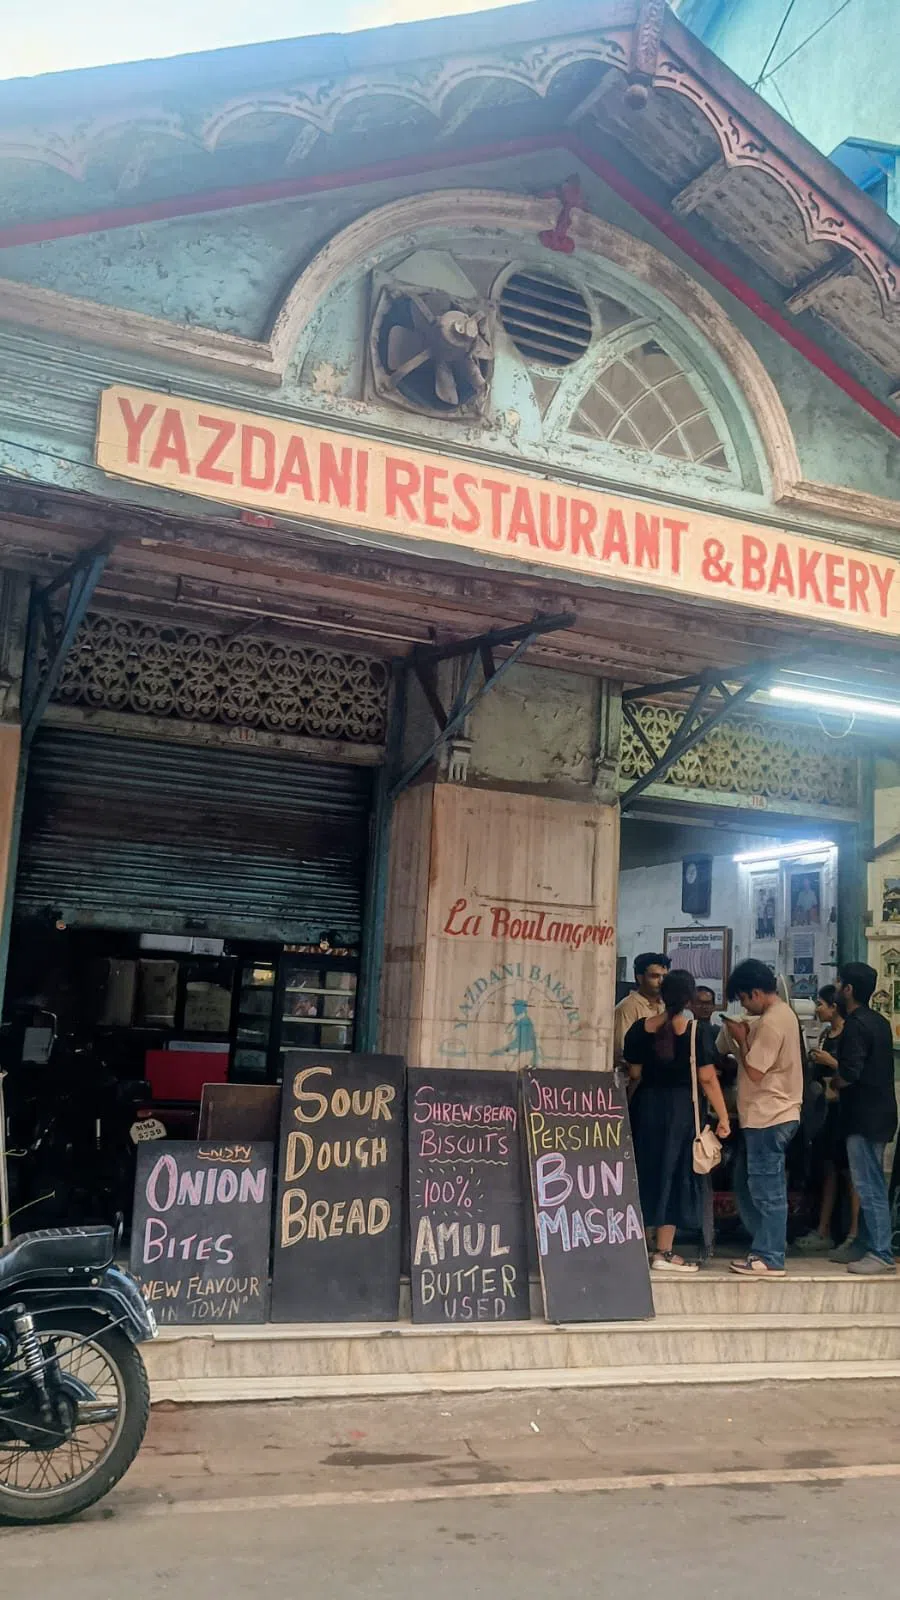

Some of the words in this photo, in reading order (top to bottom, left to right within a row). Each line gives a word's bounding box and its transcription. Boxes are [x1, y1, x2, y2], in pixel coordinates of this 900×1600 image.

[117, 396, 369, 512] YAZDANI
[385, 456, 689, 576] RESTAURANT
[702, 538, 735, 587] &
[742, 534, 896, 618] BAKERY
[443, 897, 482, 936] La
[453, 961, 523, 1033] YAZDANI
[293, 1066, 396, 1123] SOUR
[413, 1086, 517, 1131] SHREWSBERRY
[285, 1131, 388, 1182] DOUGH
[419, 1129, 509, 1157] BISCUITS
[530, 1112, 624, 1156] PERSIAN
[145, 1154, 267, 1212] ONION
[424, 1175, 472, 1208] 100%
[536, 1152, 624, 1207] BUN
[143, 1217, 234, 1264] BITES
[281, 1188, 391, 1248] BREAD
[413, 1216, 510, 1265] AMUL
[537, 1204, 644, 1256] MASKA
[186, 1275, 260, 1300] FLAVOUR
[421, 1264, 516, 1305] BUTTER
[444, 1296, 506, 1320] USED
[160, 1305, 178, 1322] IN
